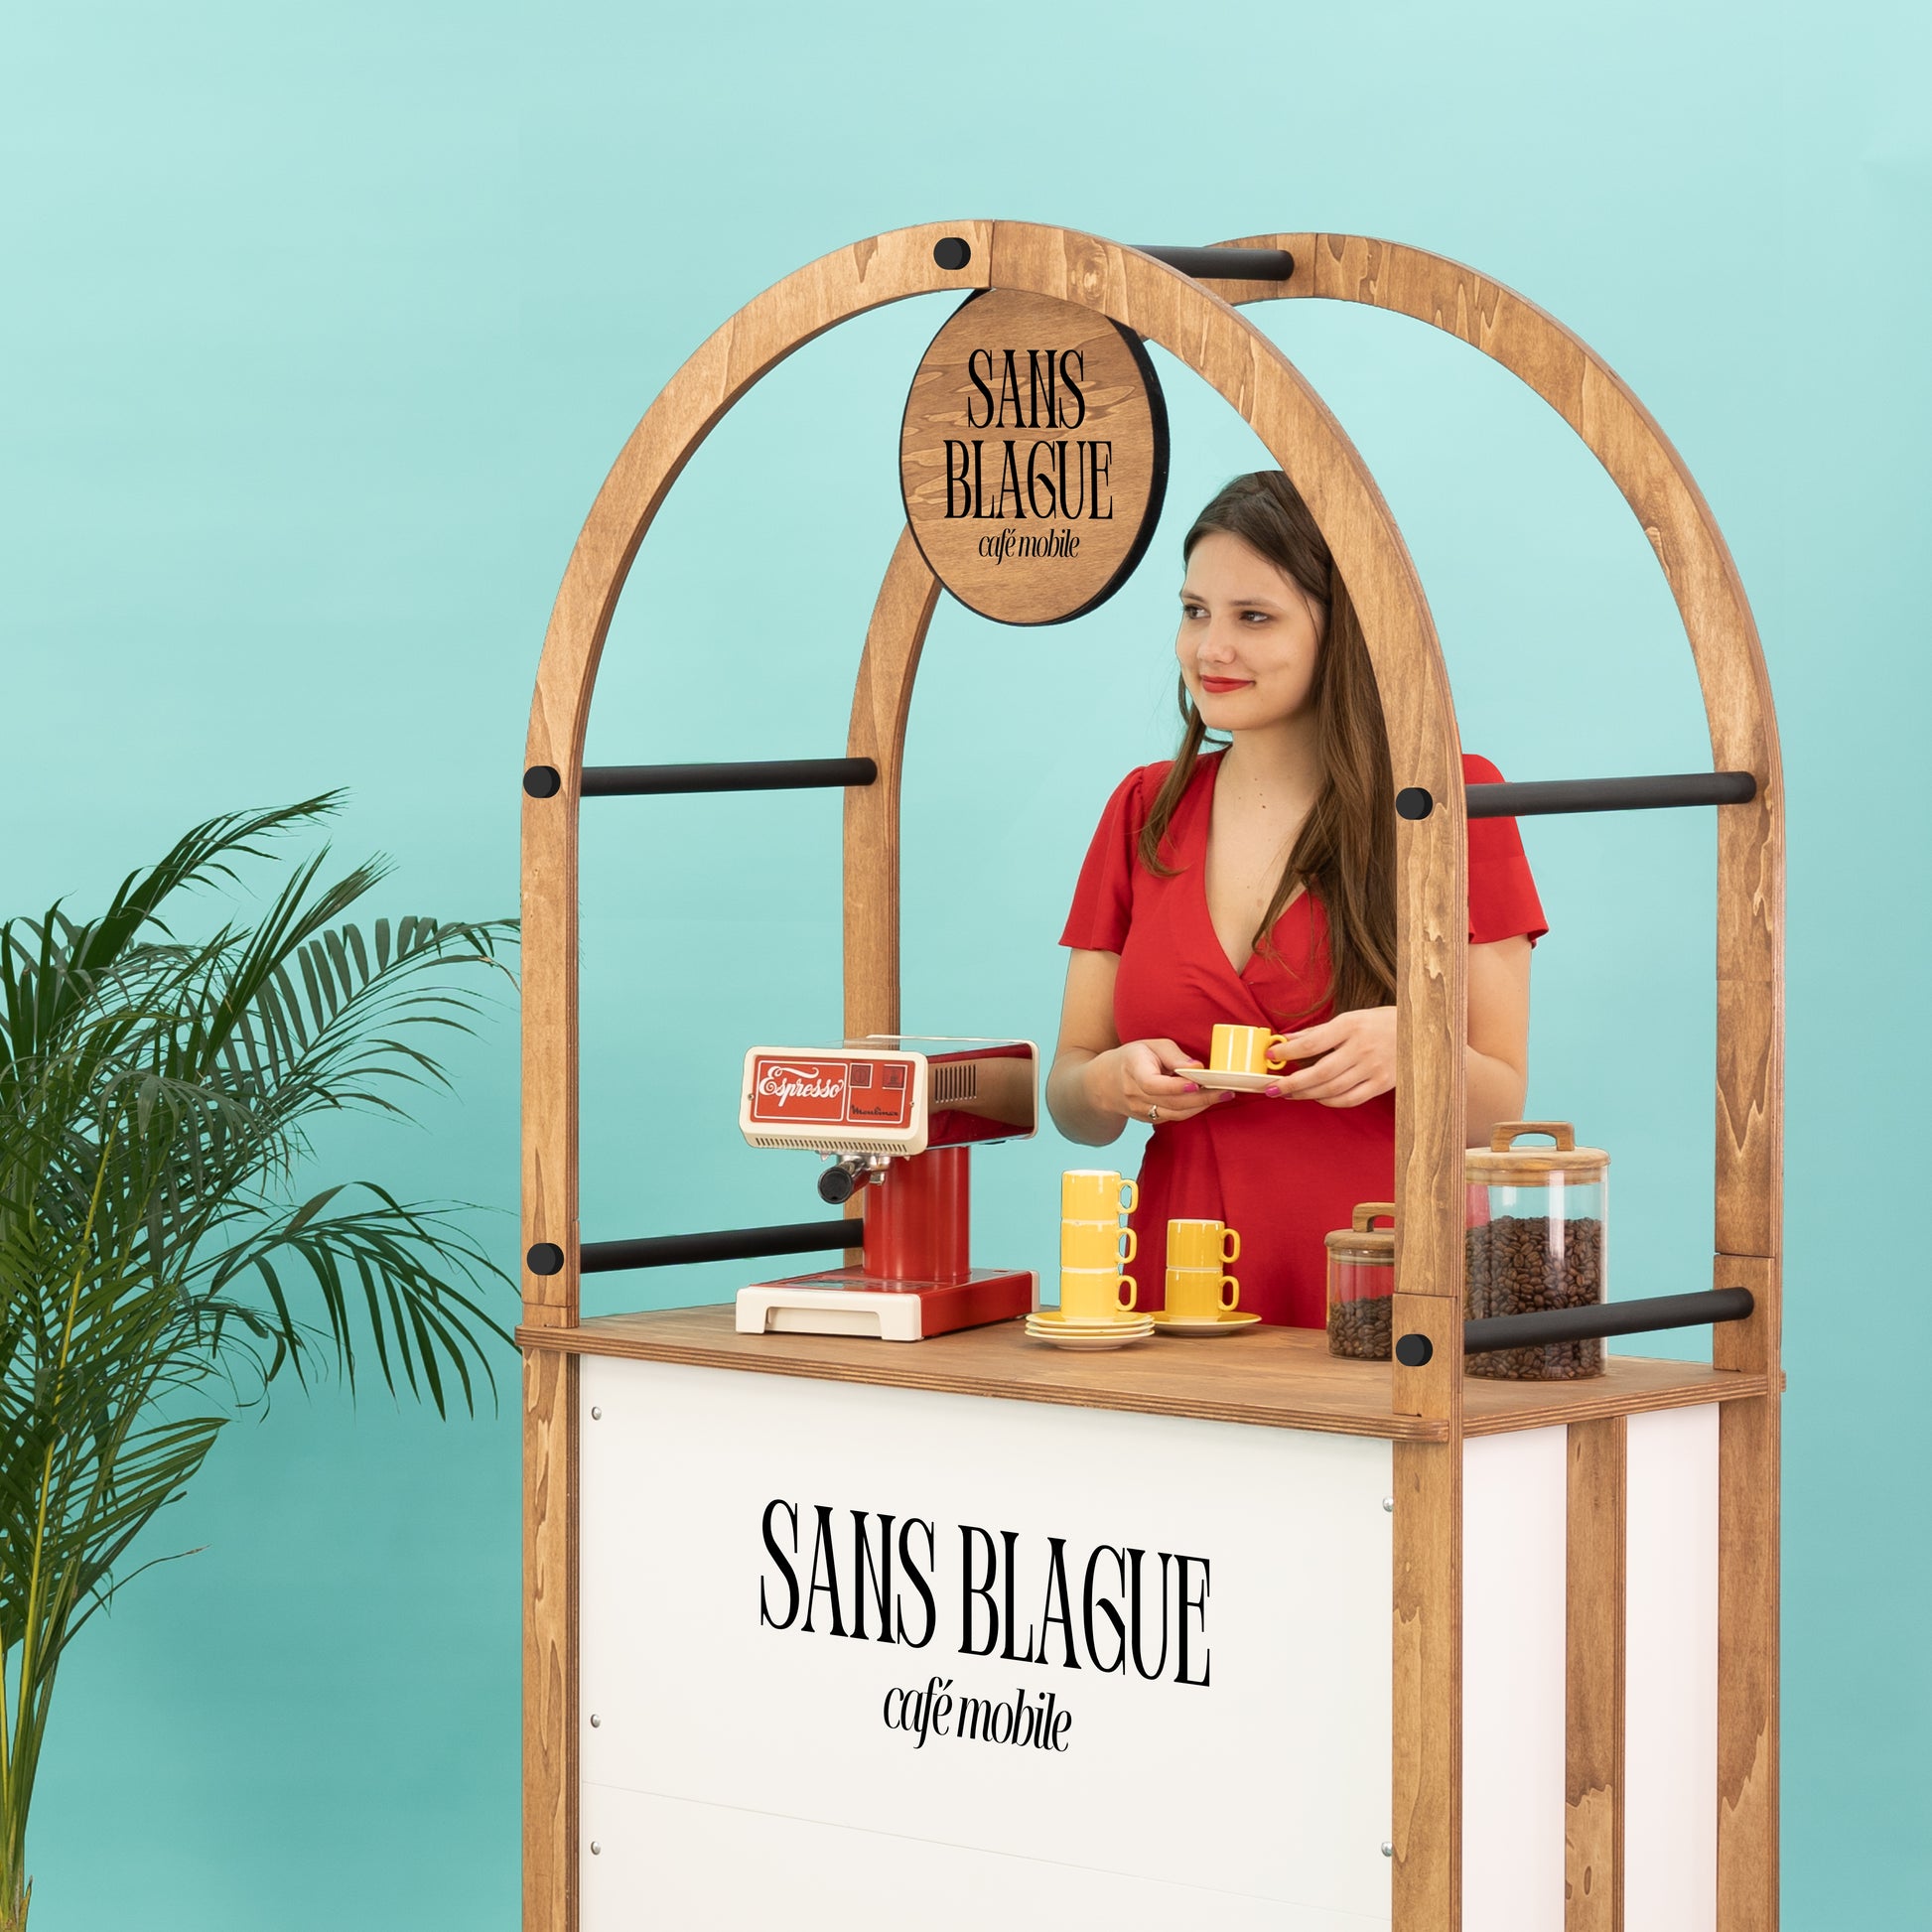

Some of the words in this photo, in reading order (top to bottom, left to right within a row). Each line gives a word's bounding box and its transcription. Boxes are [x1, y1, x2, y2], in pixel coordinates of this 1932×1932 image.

[968, 348, 1086, 429] SANS
[943, 440, 1113, 519] BLAGUE
[978, 528, 1017, 565] café
[1018, 528, 1080, 558] mobile
[759, 1065, 845, 1107] Espresso
[760, 1498, 936, 1649] SANS
[957, 1525, 1210, 1687] BLAGUE
[883, 1676, 954, 1749] café
[956, 1688, 1072, 1752] mobile
